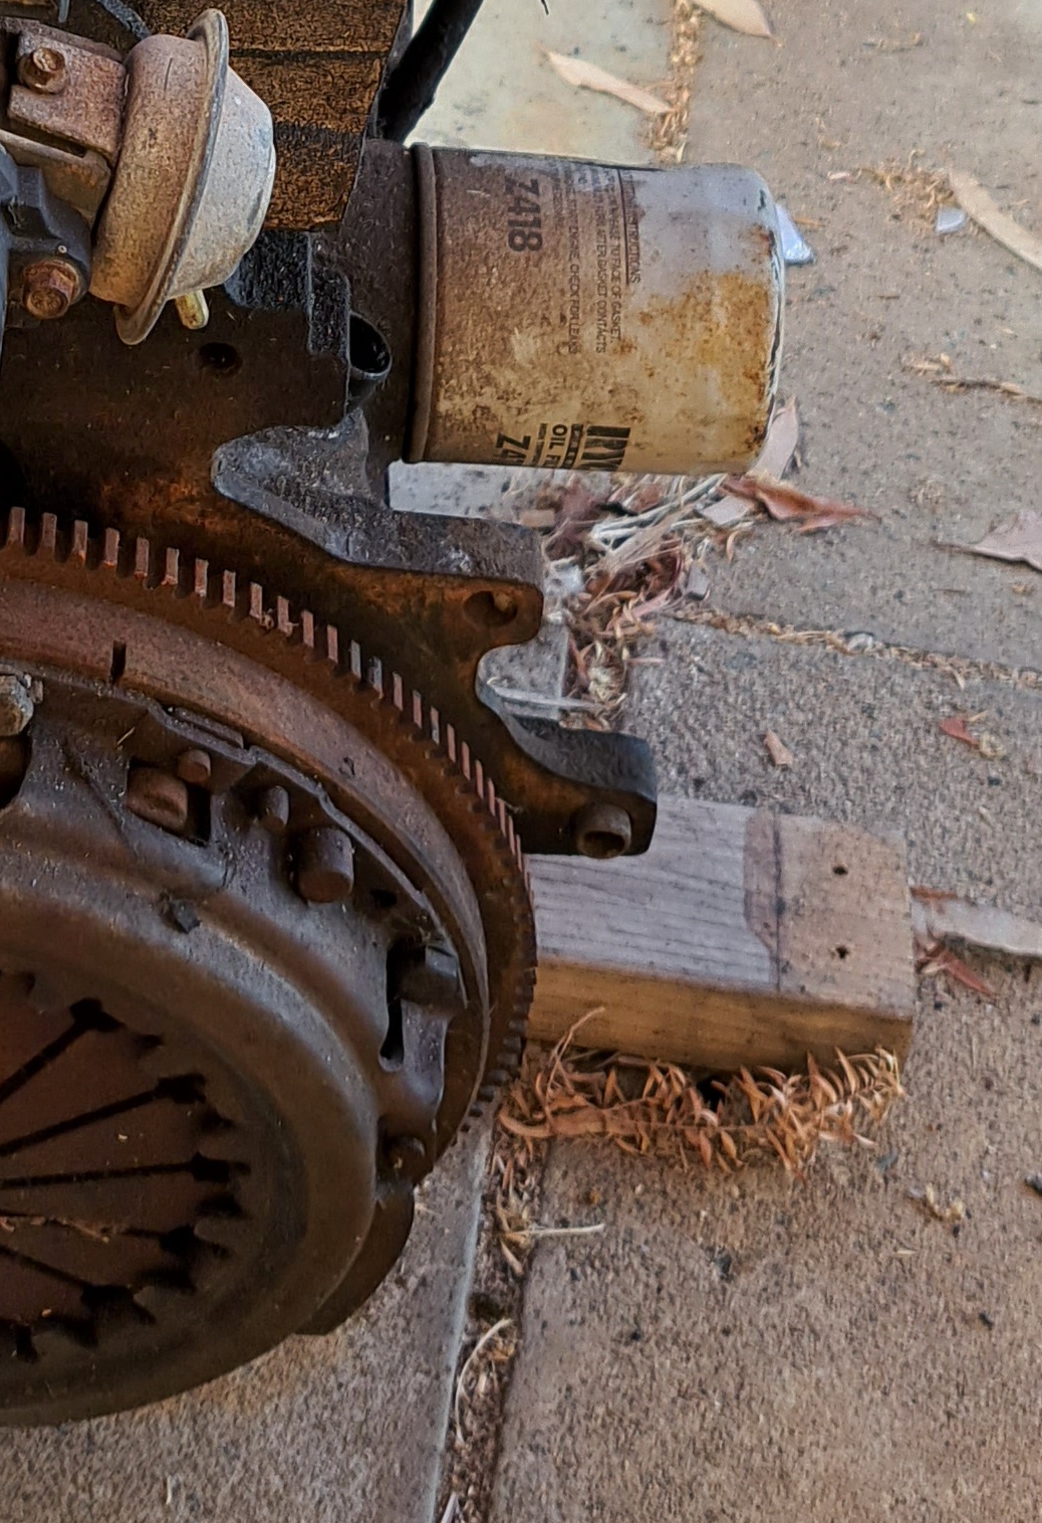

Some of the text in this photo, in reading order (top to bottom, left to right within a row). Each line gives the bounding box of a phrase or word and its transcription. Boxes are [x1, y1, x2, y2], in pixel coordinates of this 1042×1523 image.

[569, 263, 580, 297] CHECK
[610, 285, 621, 299] OF
[569, 299, 580, 320] FOR
[596, 300, 608, 353] CONTACTS
[549, 424, 567, 449] OIL
